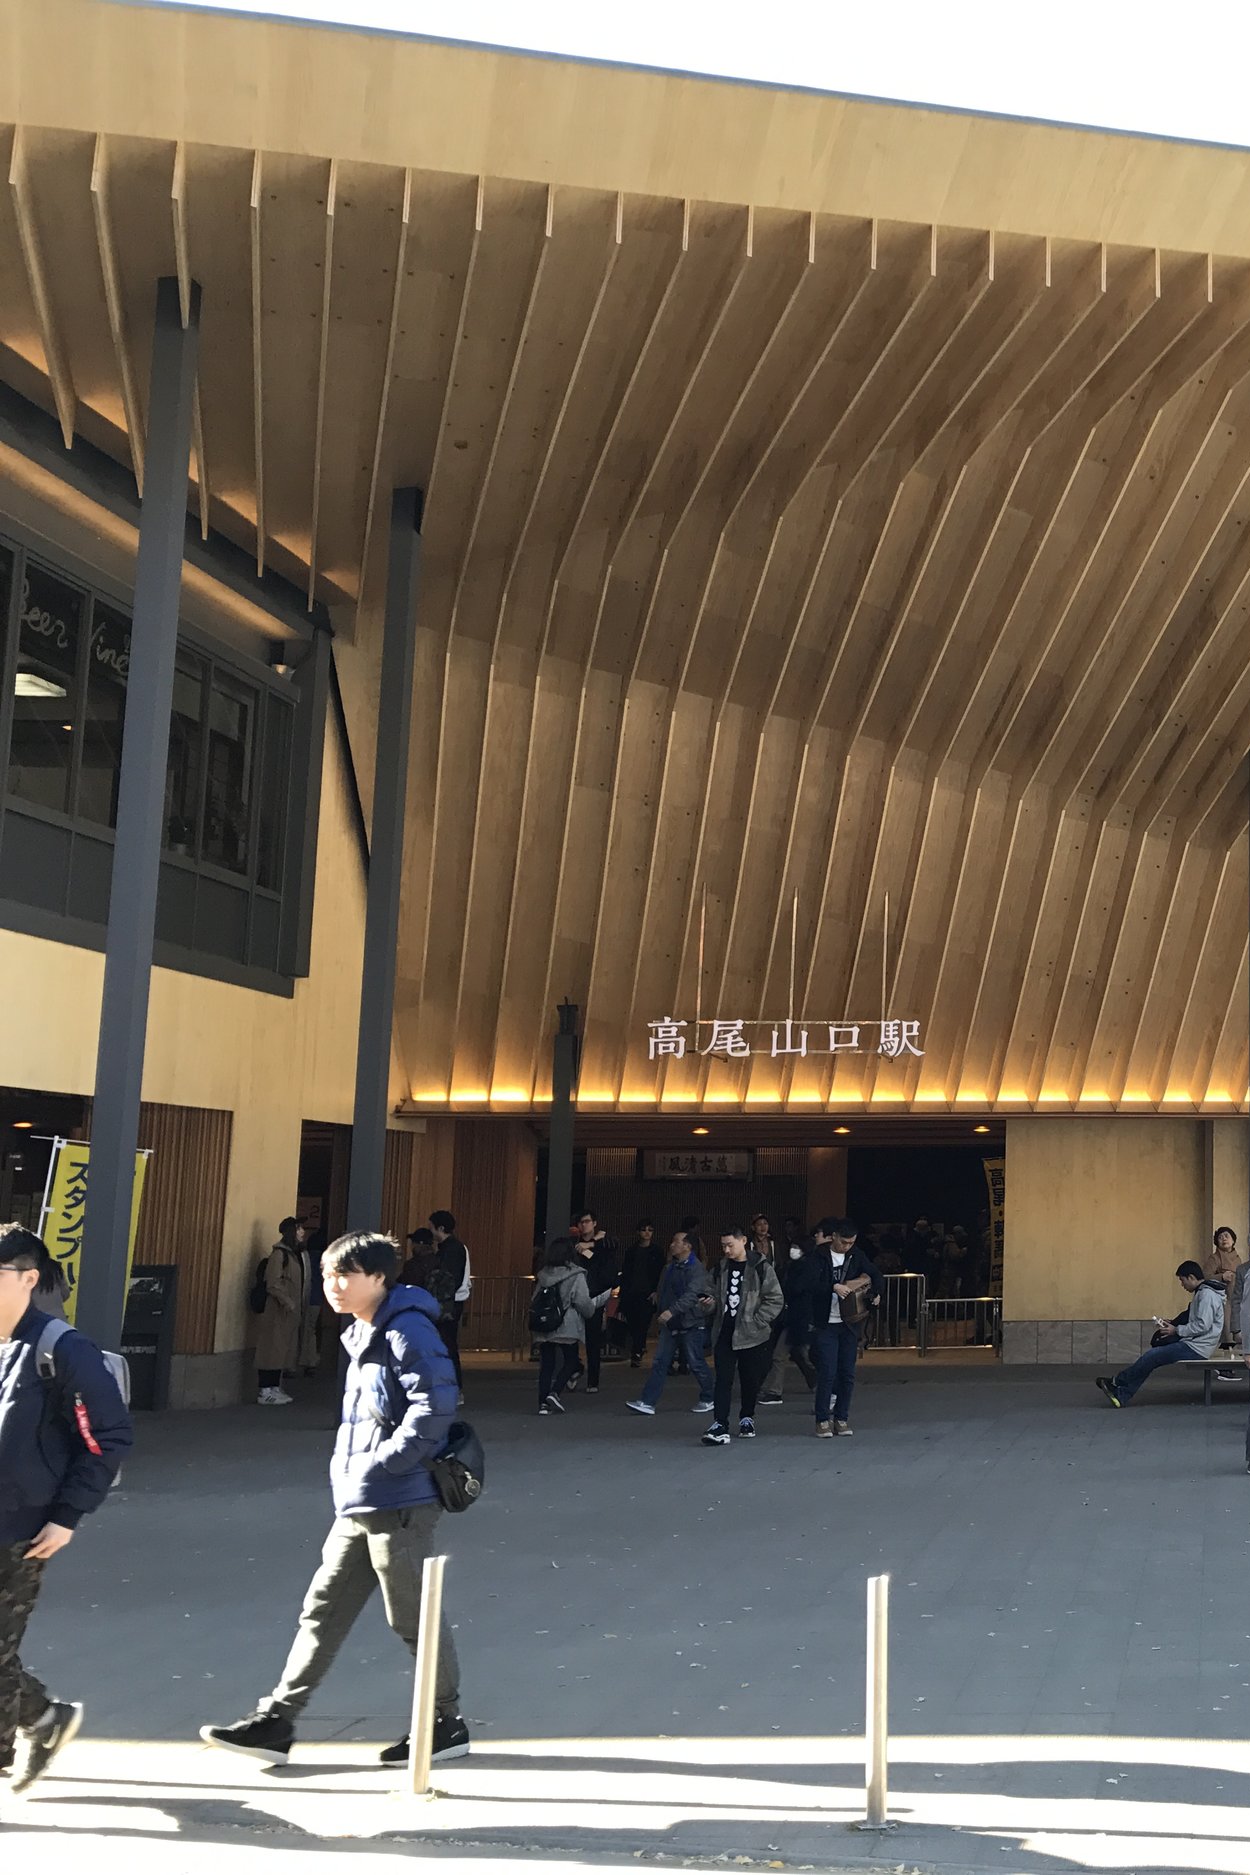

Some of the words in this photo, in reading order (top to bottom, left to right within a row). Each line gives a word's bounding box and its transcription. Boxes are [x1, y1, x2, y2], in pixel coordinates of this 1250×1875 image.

[647, 1016, 926, 1060] 高尾山口駅
